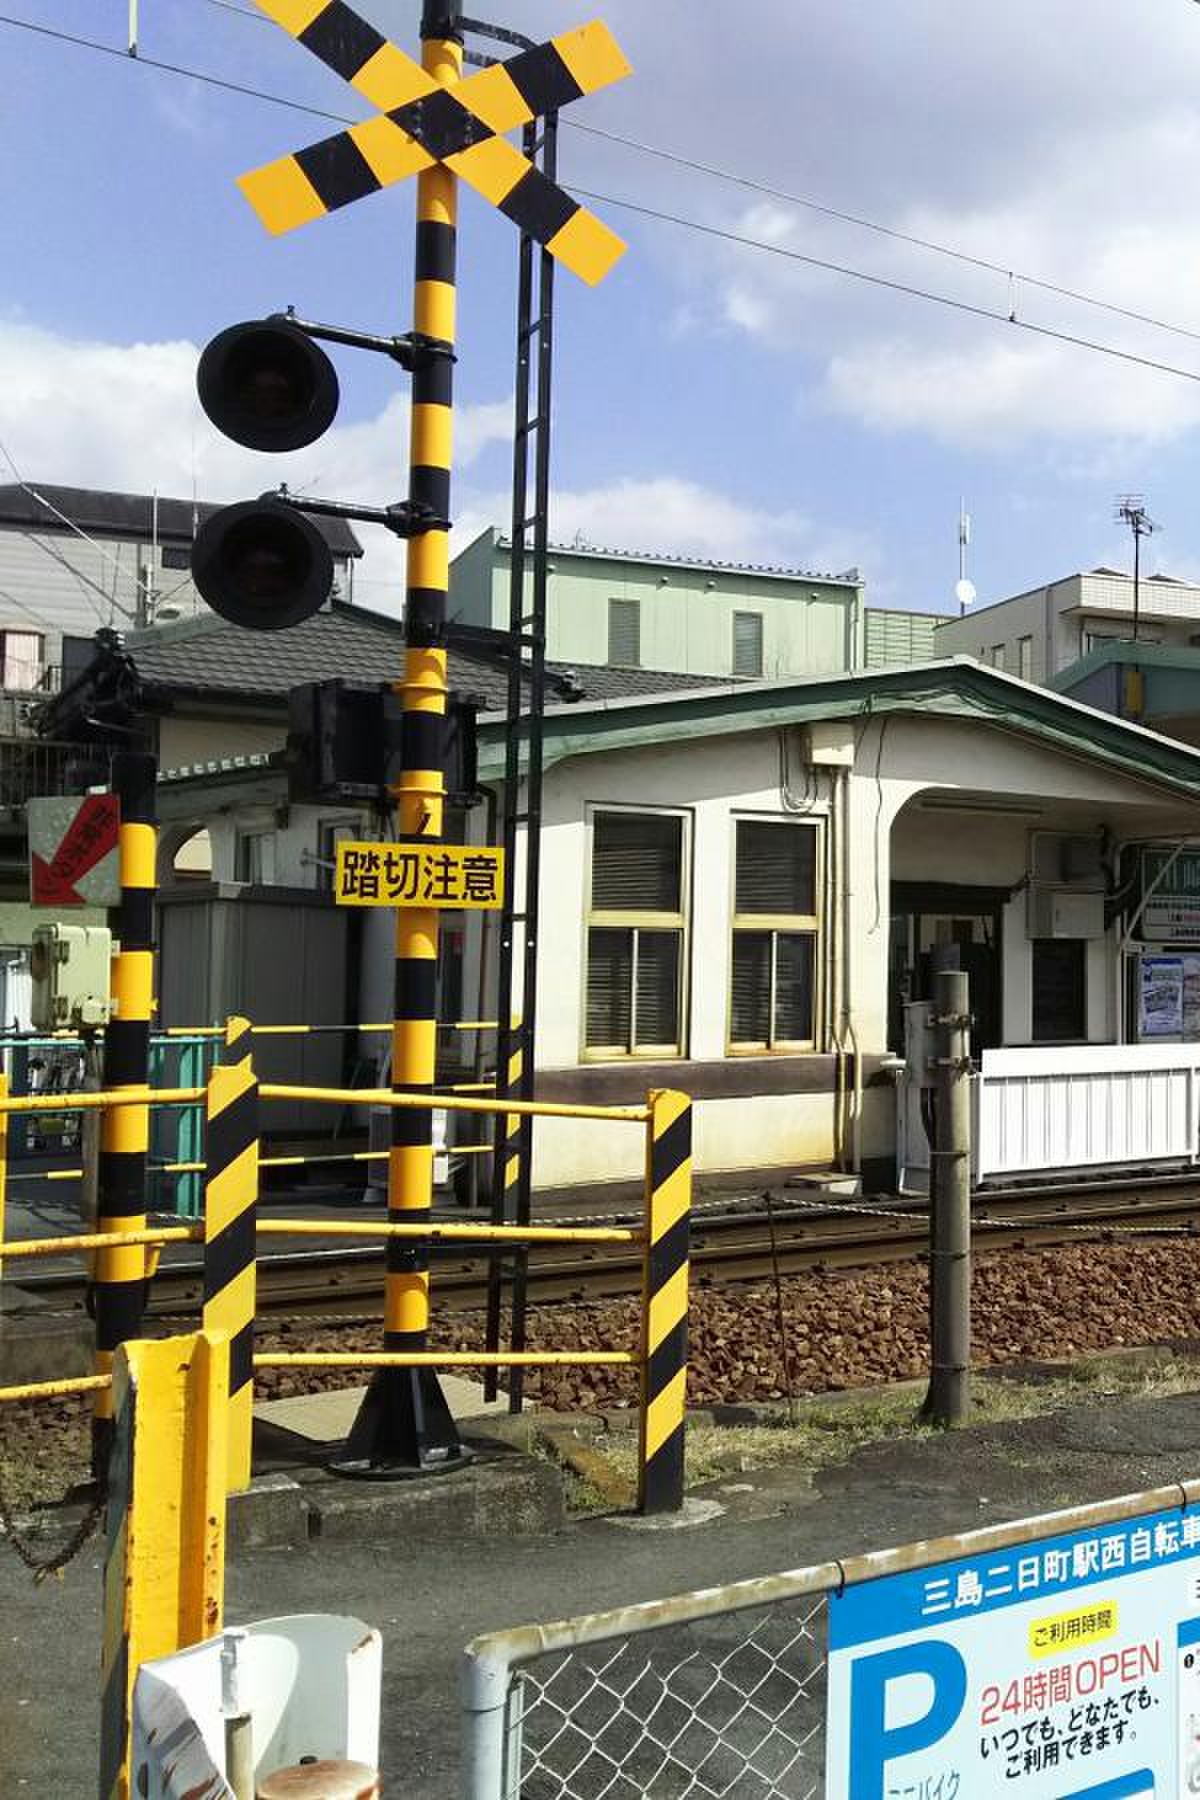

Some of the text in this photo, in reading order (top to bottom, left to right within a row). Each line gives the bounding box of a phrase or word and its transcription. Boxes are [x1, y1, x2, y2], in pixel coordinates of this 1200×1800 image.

[341, 849, 499, 902] 踏切注意
[1033, 1608, 1113, 1648] ご利用時間
[979, 1639, 1161, 1726] 24時間OPEN
[850, 1639, 968, 1800] P
[980, 1685, 1160, 1759] いつでも、どなたでも、
[1004, 1717, 1137, 1779] ご利用できます。
